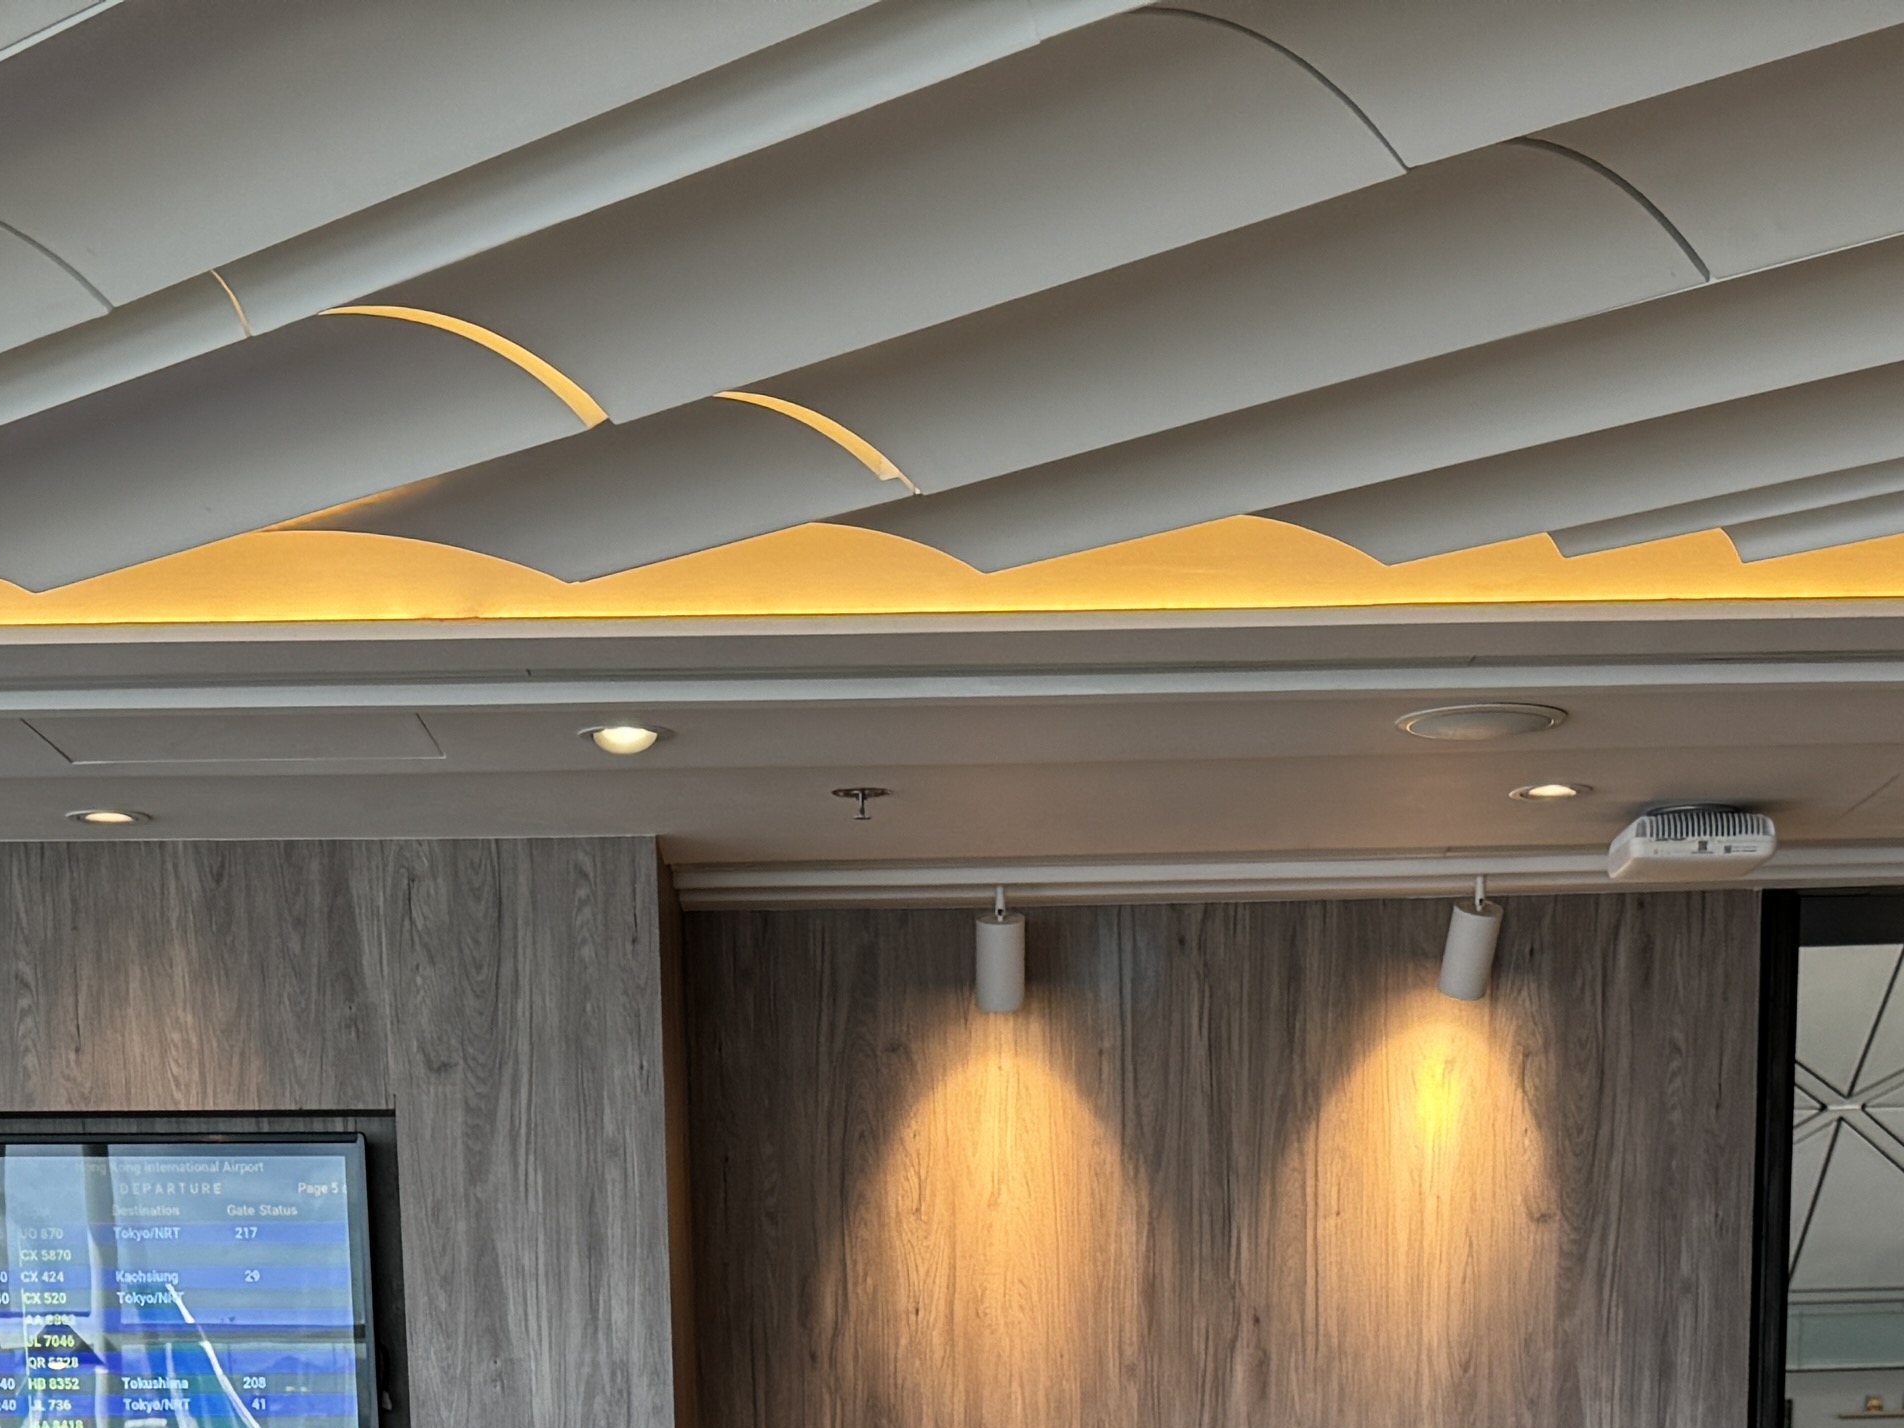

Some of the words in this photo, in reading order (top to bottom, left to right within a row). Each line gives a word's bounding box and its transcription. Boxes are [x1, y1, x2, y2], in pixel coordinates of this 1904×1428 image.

[144, 1160, 219, 1174] International
[222, 1160, 264, 1176] Airport
[119, 1182, 223, 1196] DEPARTURE
[297, 1182, 329, 1198] Page
[112, 1204, 181, 1218] Destination
[226, 1204, 256, 1217] Gate
[259, 1204, 298, 1217] Status
[112, 1226, 181, 1241] Tokyo/NRT
[234, 1226, 258, 1239] 217
[20, 1249, 38, 1262] CX
[41, 1249, 72, 1262] 5870
[20, 1271, 39, 1283] CX
[41, 1271, 65, 1283] 424
[23, 1292, 41, 1304] CX
[43, 1292, 67, 1304] 520
[44, 1335, 75, 1347] 7046
[47, 1399, 72, 1411] 736
[251, 1398, 266, 1411] 41
